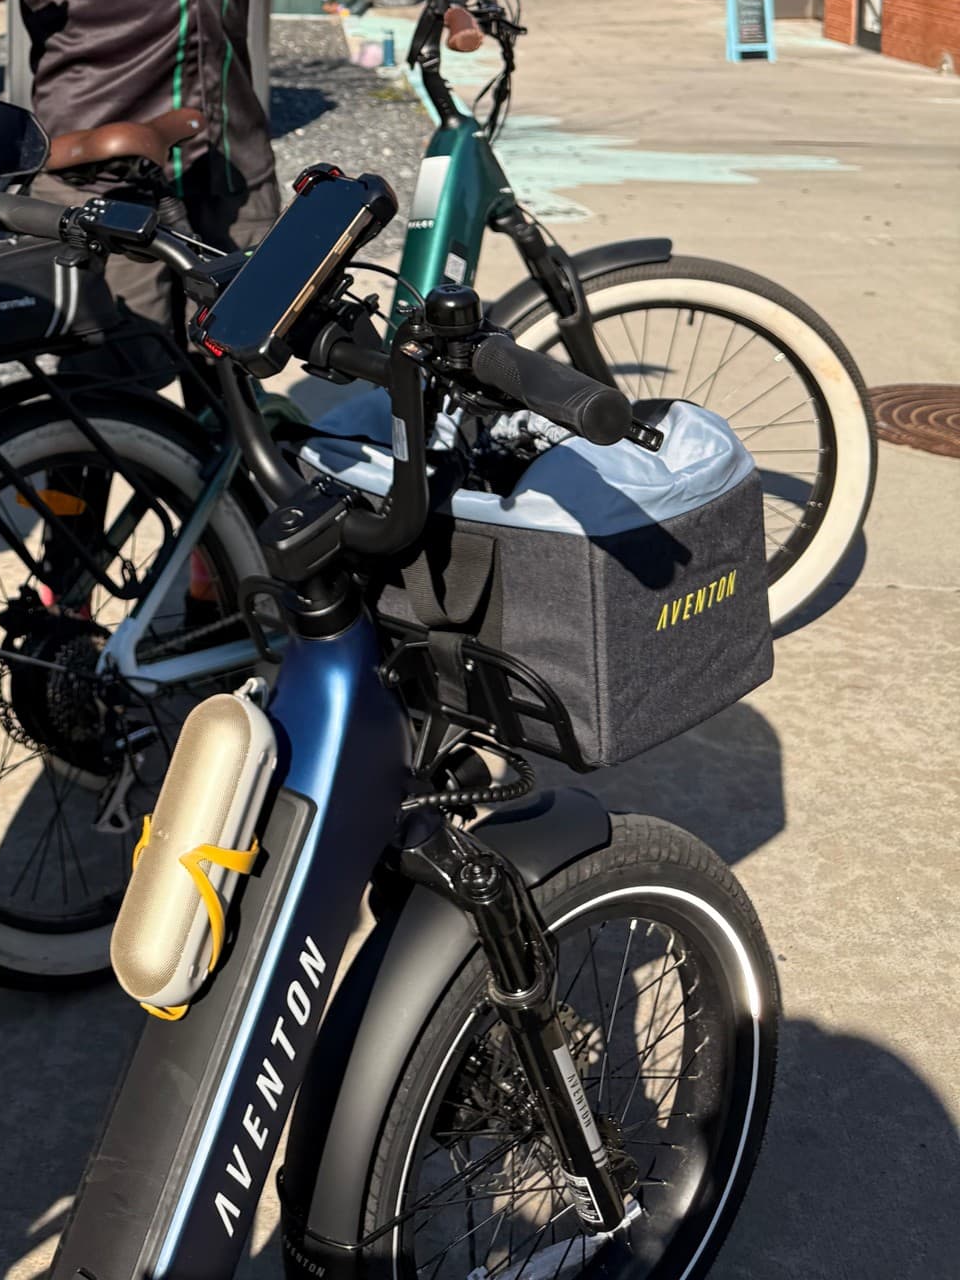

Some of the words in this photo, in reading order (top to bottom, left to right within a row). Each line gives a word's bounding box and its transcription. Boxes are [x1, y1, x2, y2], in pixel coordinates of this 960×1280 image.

[656, 569, 737, 631] AVENTON
[214, 936, 327, 1238] AVENTON
[567, 1073, 592, 1128] AVENTON
